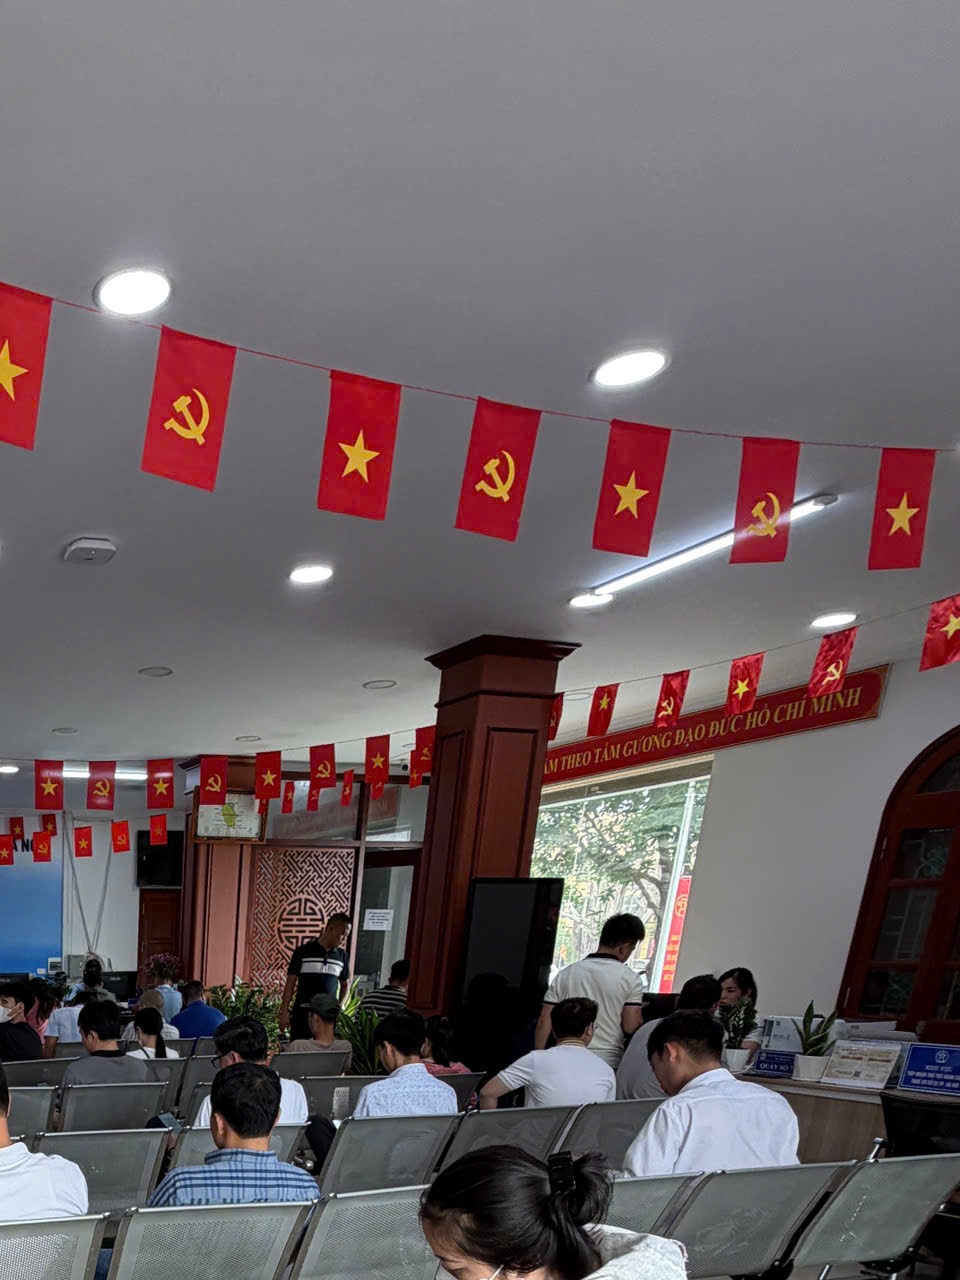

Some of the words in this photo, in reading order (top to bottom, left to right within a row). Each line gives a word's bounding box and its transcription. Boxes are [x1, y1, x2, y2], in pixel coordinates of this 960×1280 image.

[560, 750, 592, 771] THEO
[622, 731, 672, 757] GƯƠNG
[673, 723, 706, 748] ĐẠO
[773, 695, 807, 723] CHÍ
[809, 686, 862, 716] MINH
